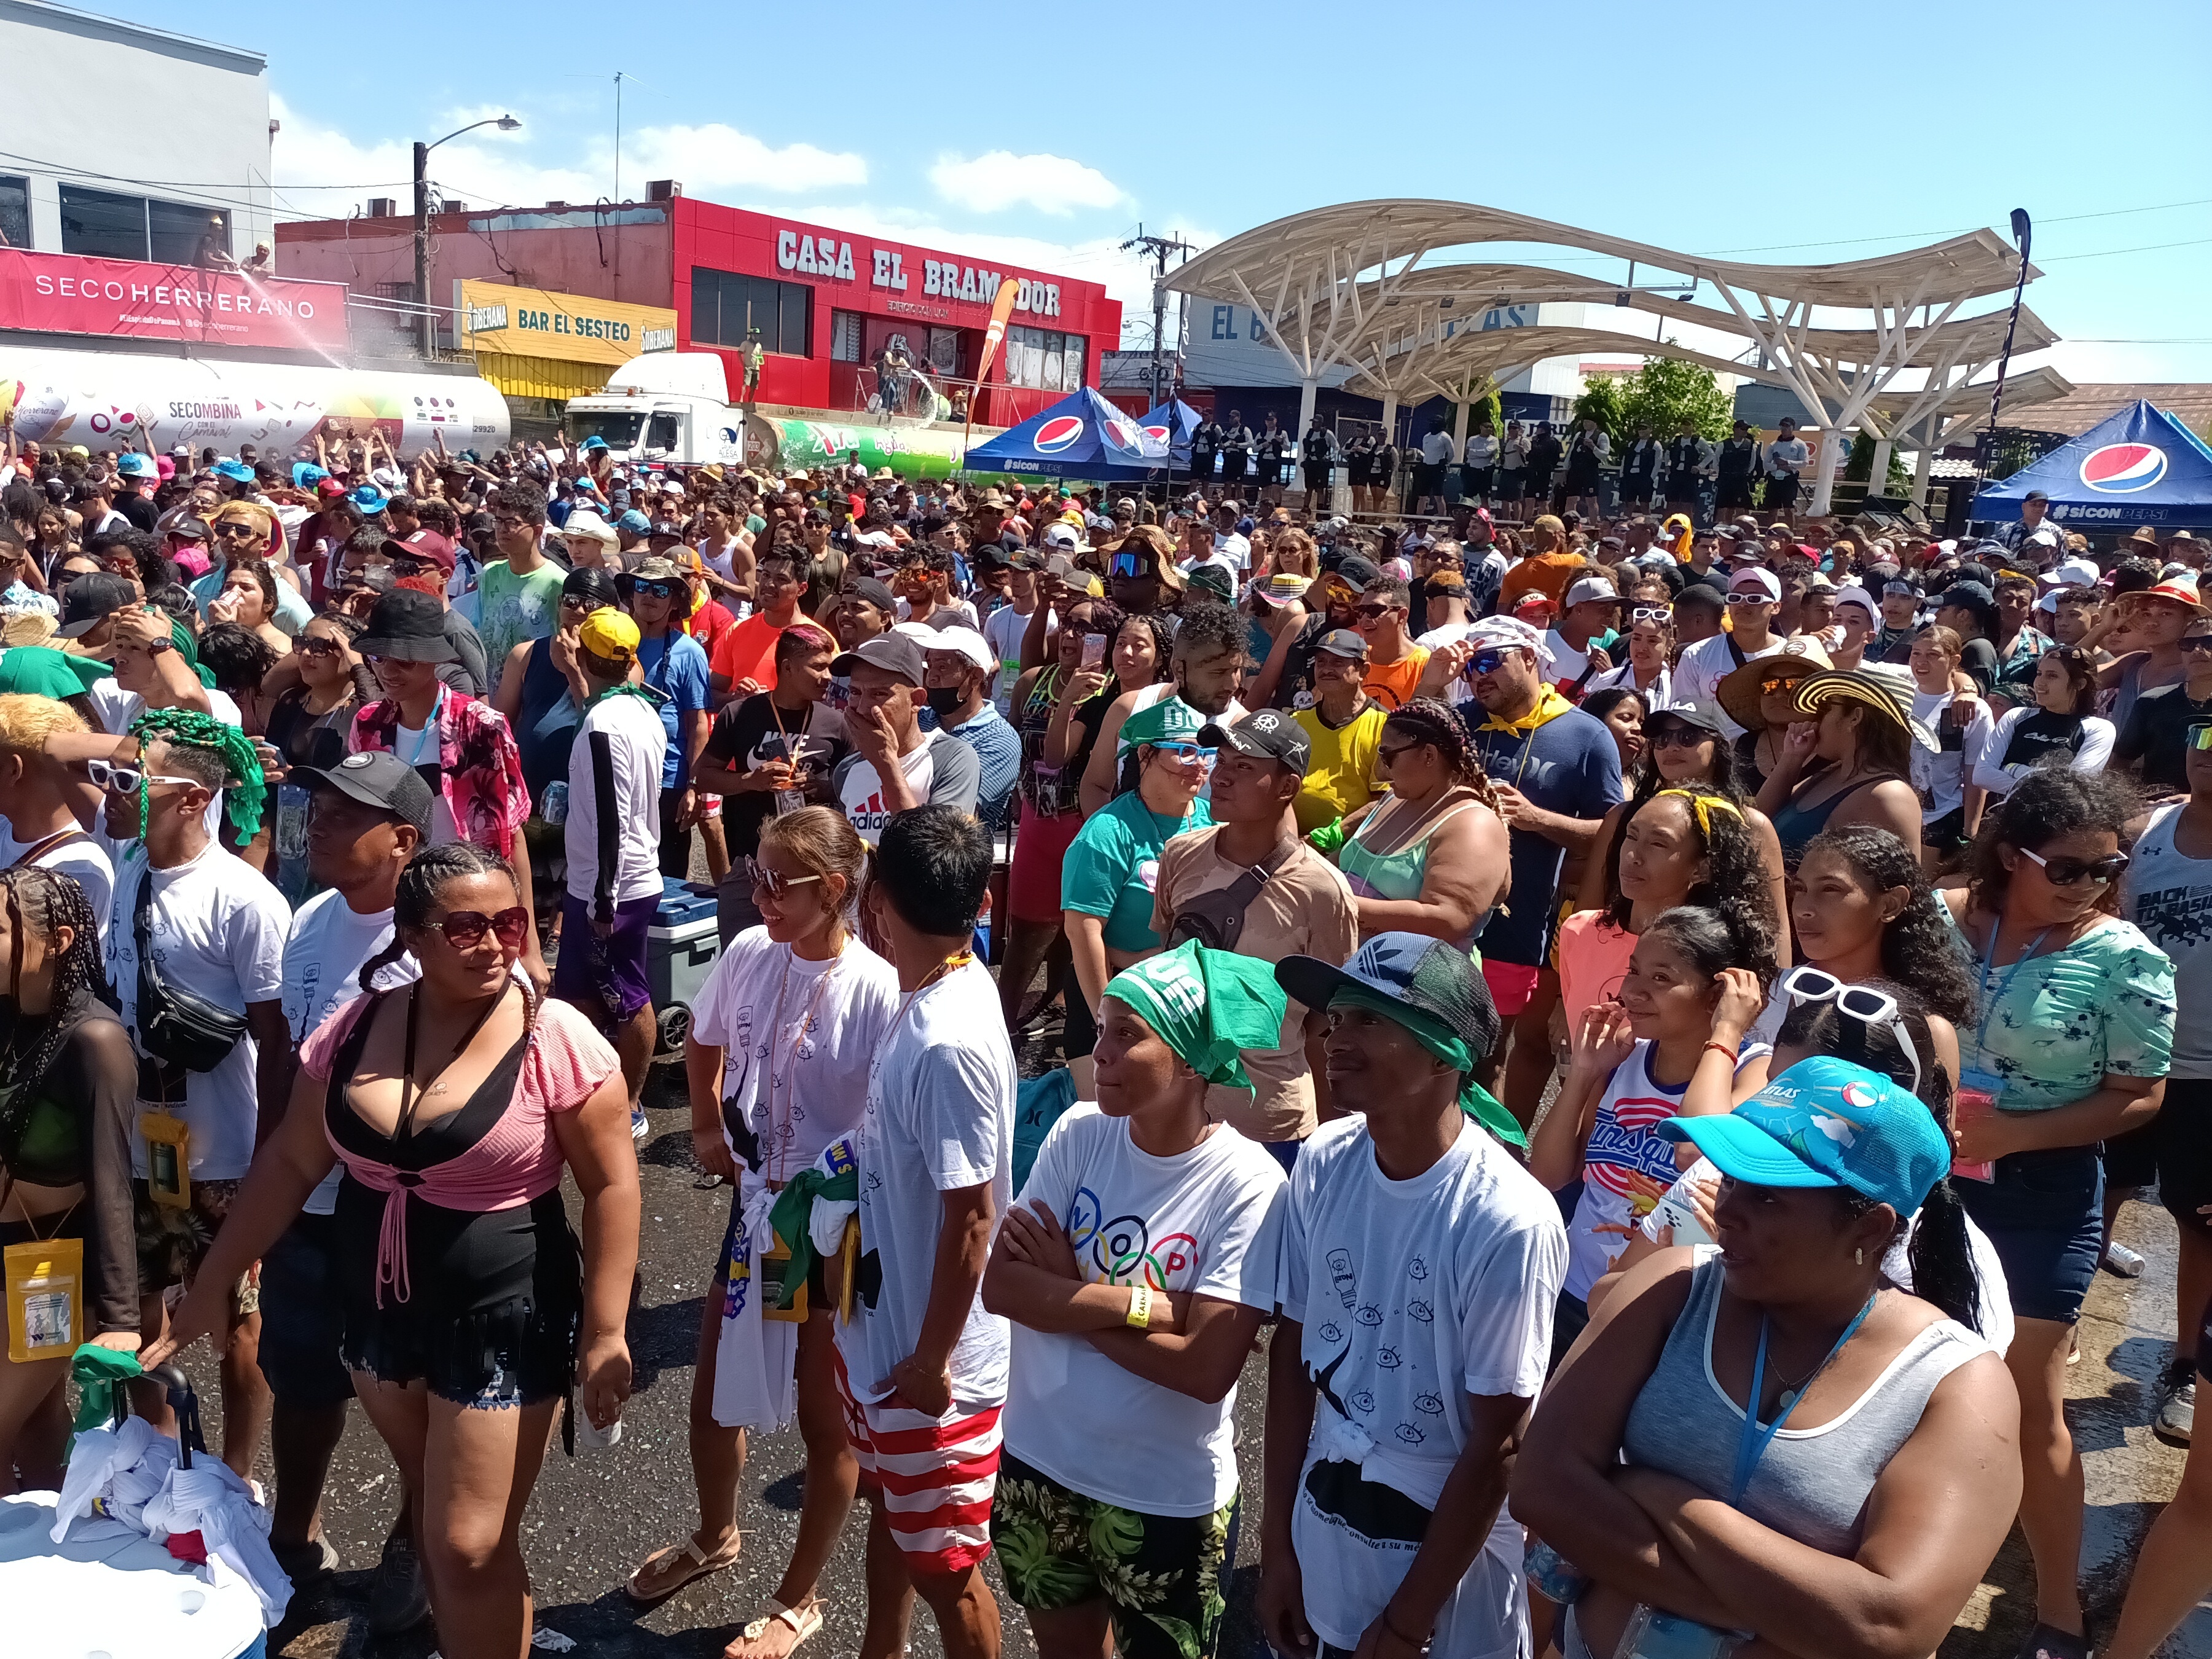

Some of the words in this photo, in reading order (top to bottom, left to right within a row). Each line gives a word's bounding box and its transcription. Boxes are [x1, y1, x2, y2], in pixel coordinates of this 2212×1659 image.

[778, 229, 856, 281] CASA
[873, 249, 908, 291] EL
[924, 259, 1061, 317] BRAMDOR
[467, 301, 507, 331] SOBERANA
[518, 308, 549, 332] BAR
[554, 313, 571, 334] EL
[575, 316, 630, 342] SESTEO
[1211, 305, 1238, 340] EL
[640, 325, 674, 352] SOBERANA
[169, 401, 242, 419] SECOMBINA
[2137, 885, 2189, 909] BACK
[1759, 1085, 1802, 1099] ATLAS
